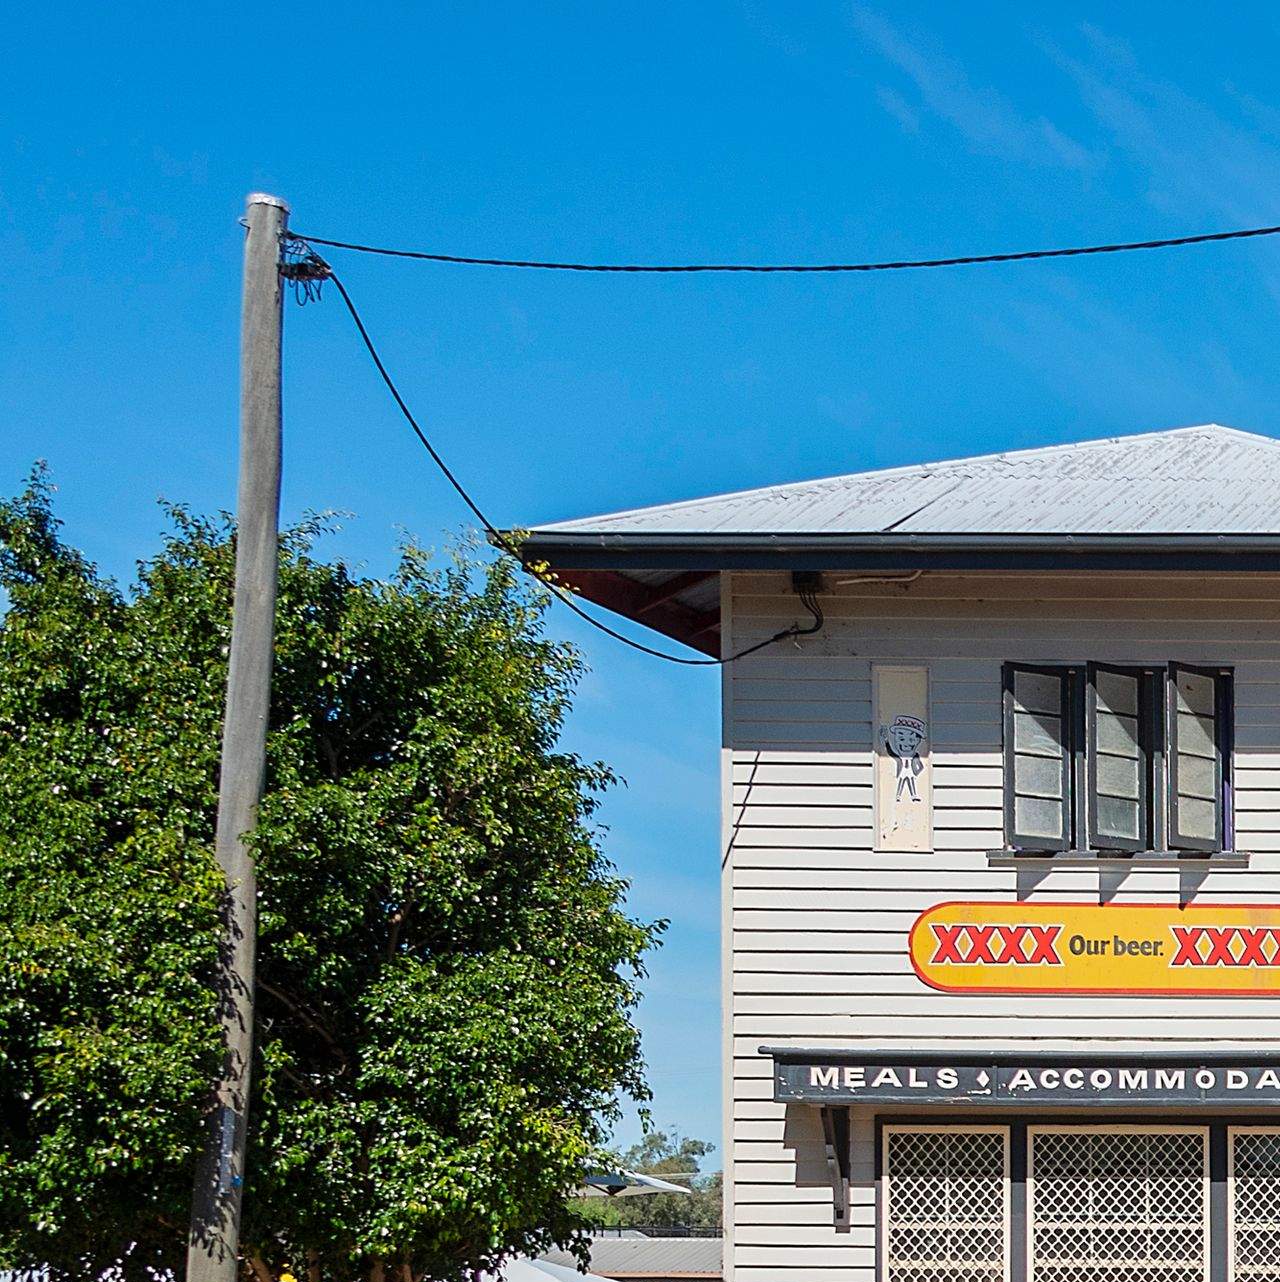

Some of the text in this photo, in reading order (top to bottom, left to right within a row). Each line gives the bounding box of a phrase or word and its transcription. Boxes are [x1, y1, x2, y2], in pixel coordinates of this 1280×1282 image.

[930, 924, 1063, 965] XXXX
[1069, 935, 1110, 956] Our
[1113, 934, 1164, 957] beer.
[809, 1066, 959, 1089] MEALS
